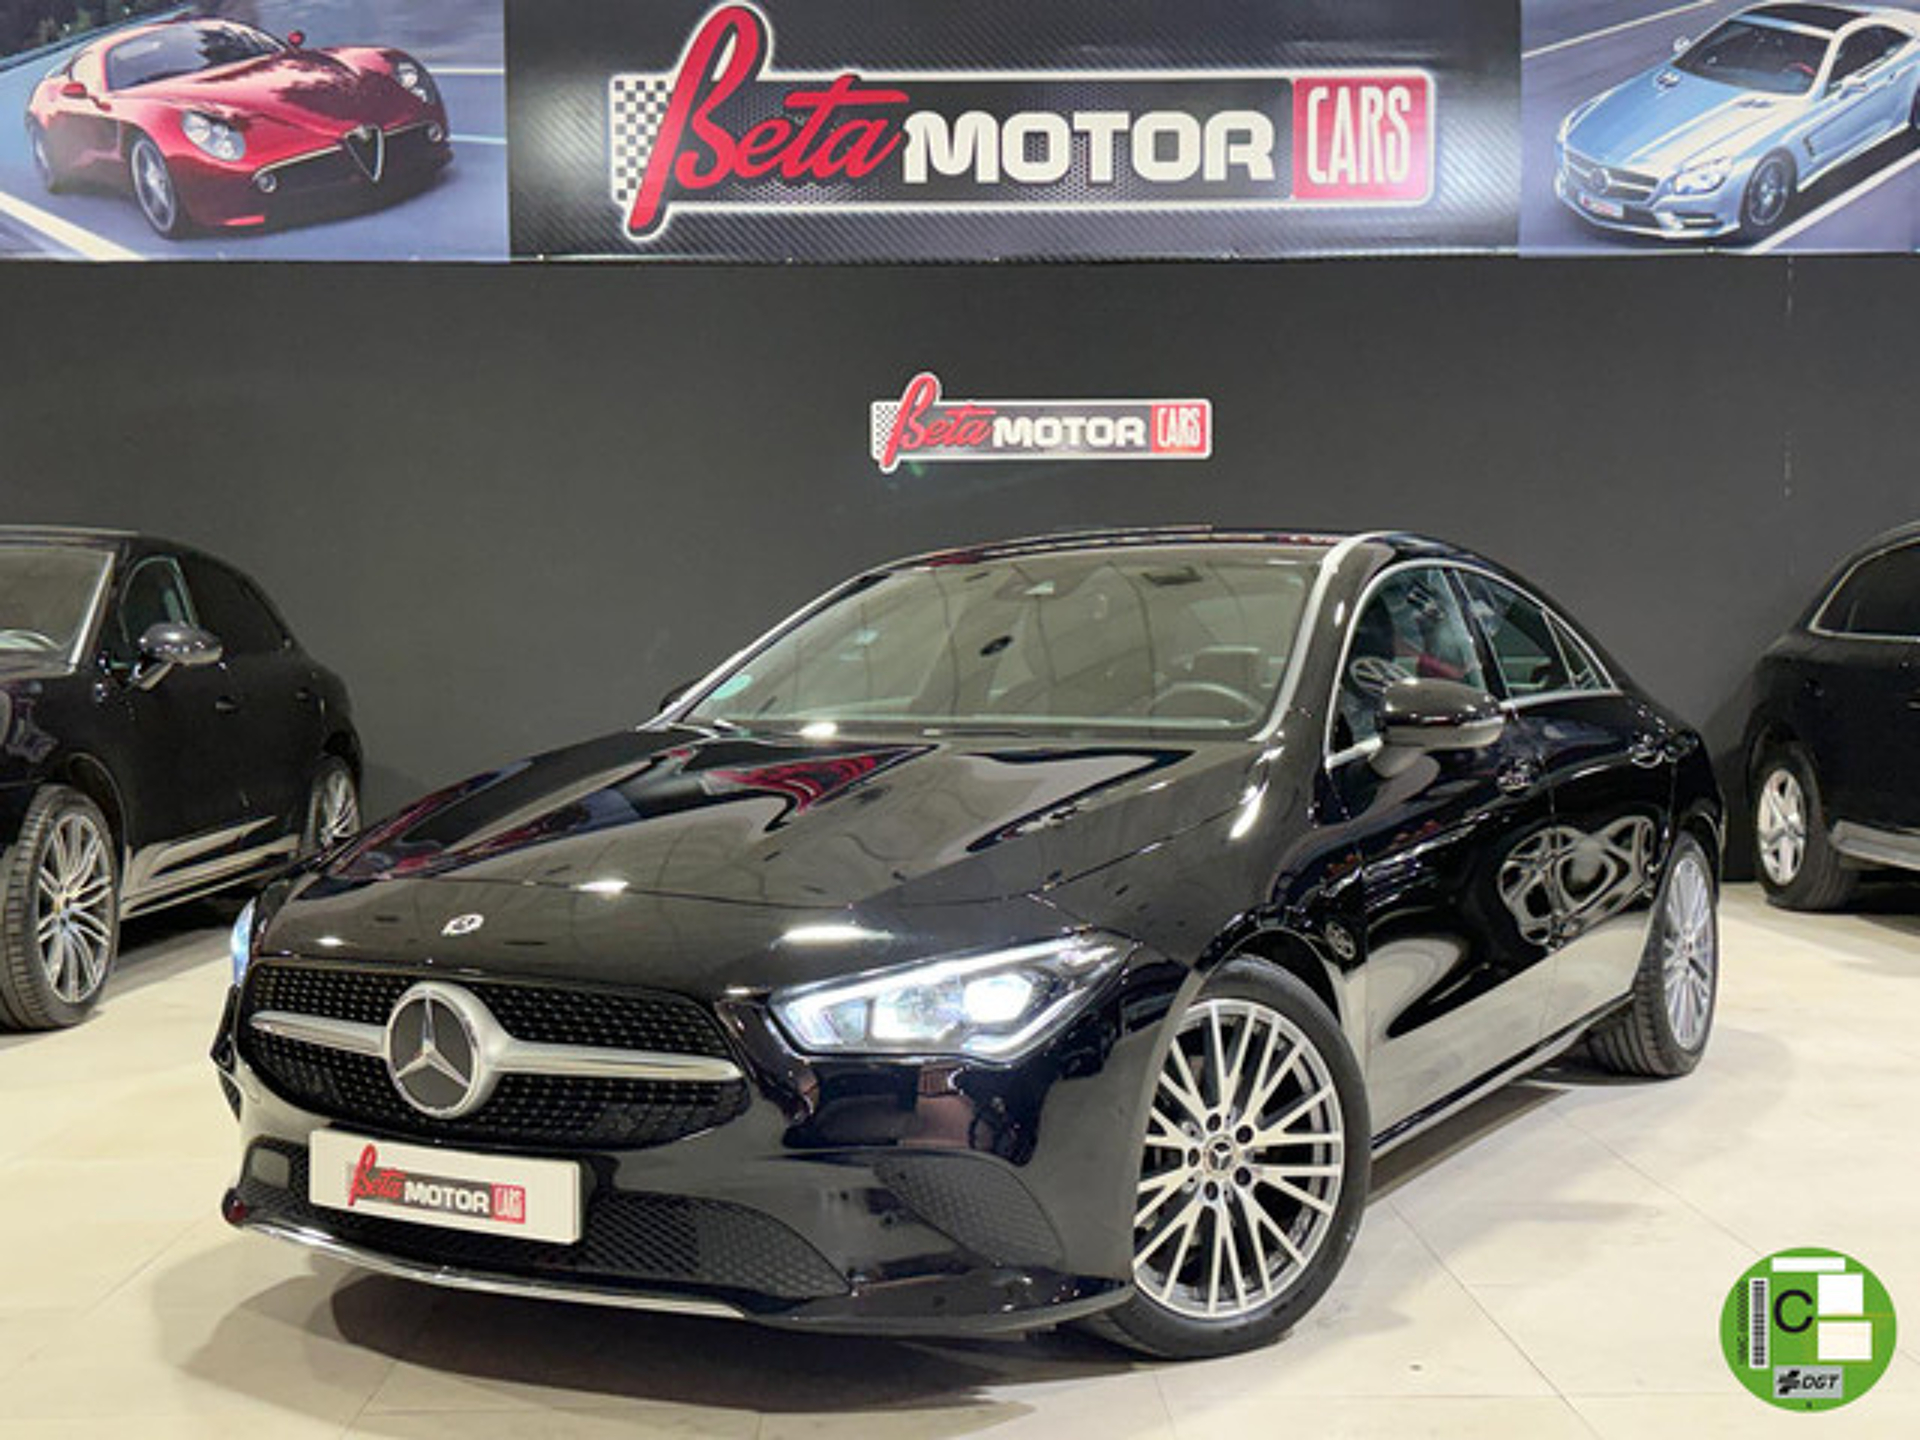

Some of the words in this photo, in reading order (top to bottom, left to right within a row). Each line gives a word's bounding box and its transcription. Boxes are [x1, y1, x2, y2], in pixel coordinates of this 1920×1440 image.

[630, 7, 910, 230] Beta
[903, 110, 1274, 184] MOTOR
[1306, 86, 1411, 186] CARS
[884, 375, 997, 466] Beta
[993, 416, 1146, 447] MOTOR
[1158, 407, 1201, 448] CARS
[404, 1181, 490, 1214] MOTOR
[495, 1187, 523, 1219] CARS
